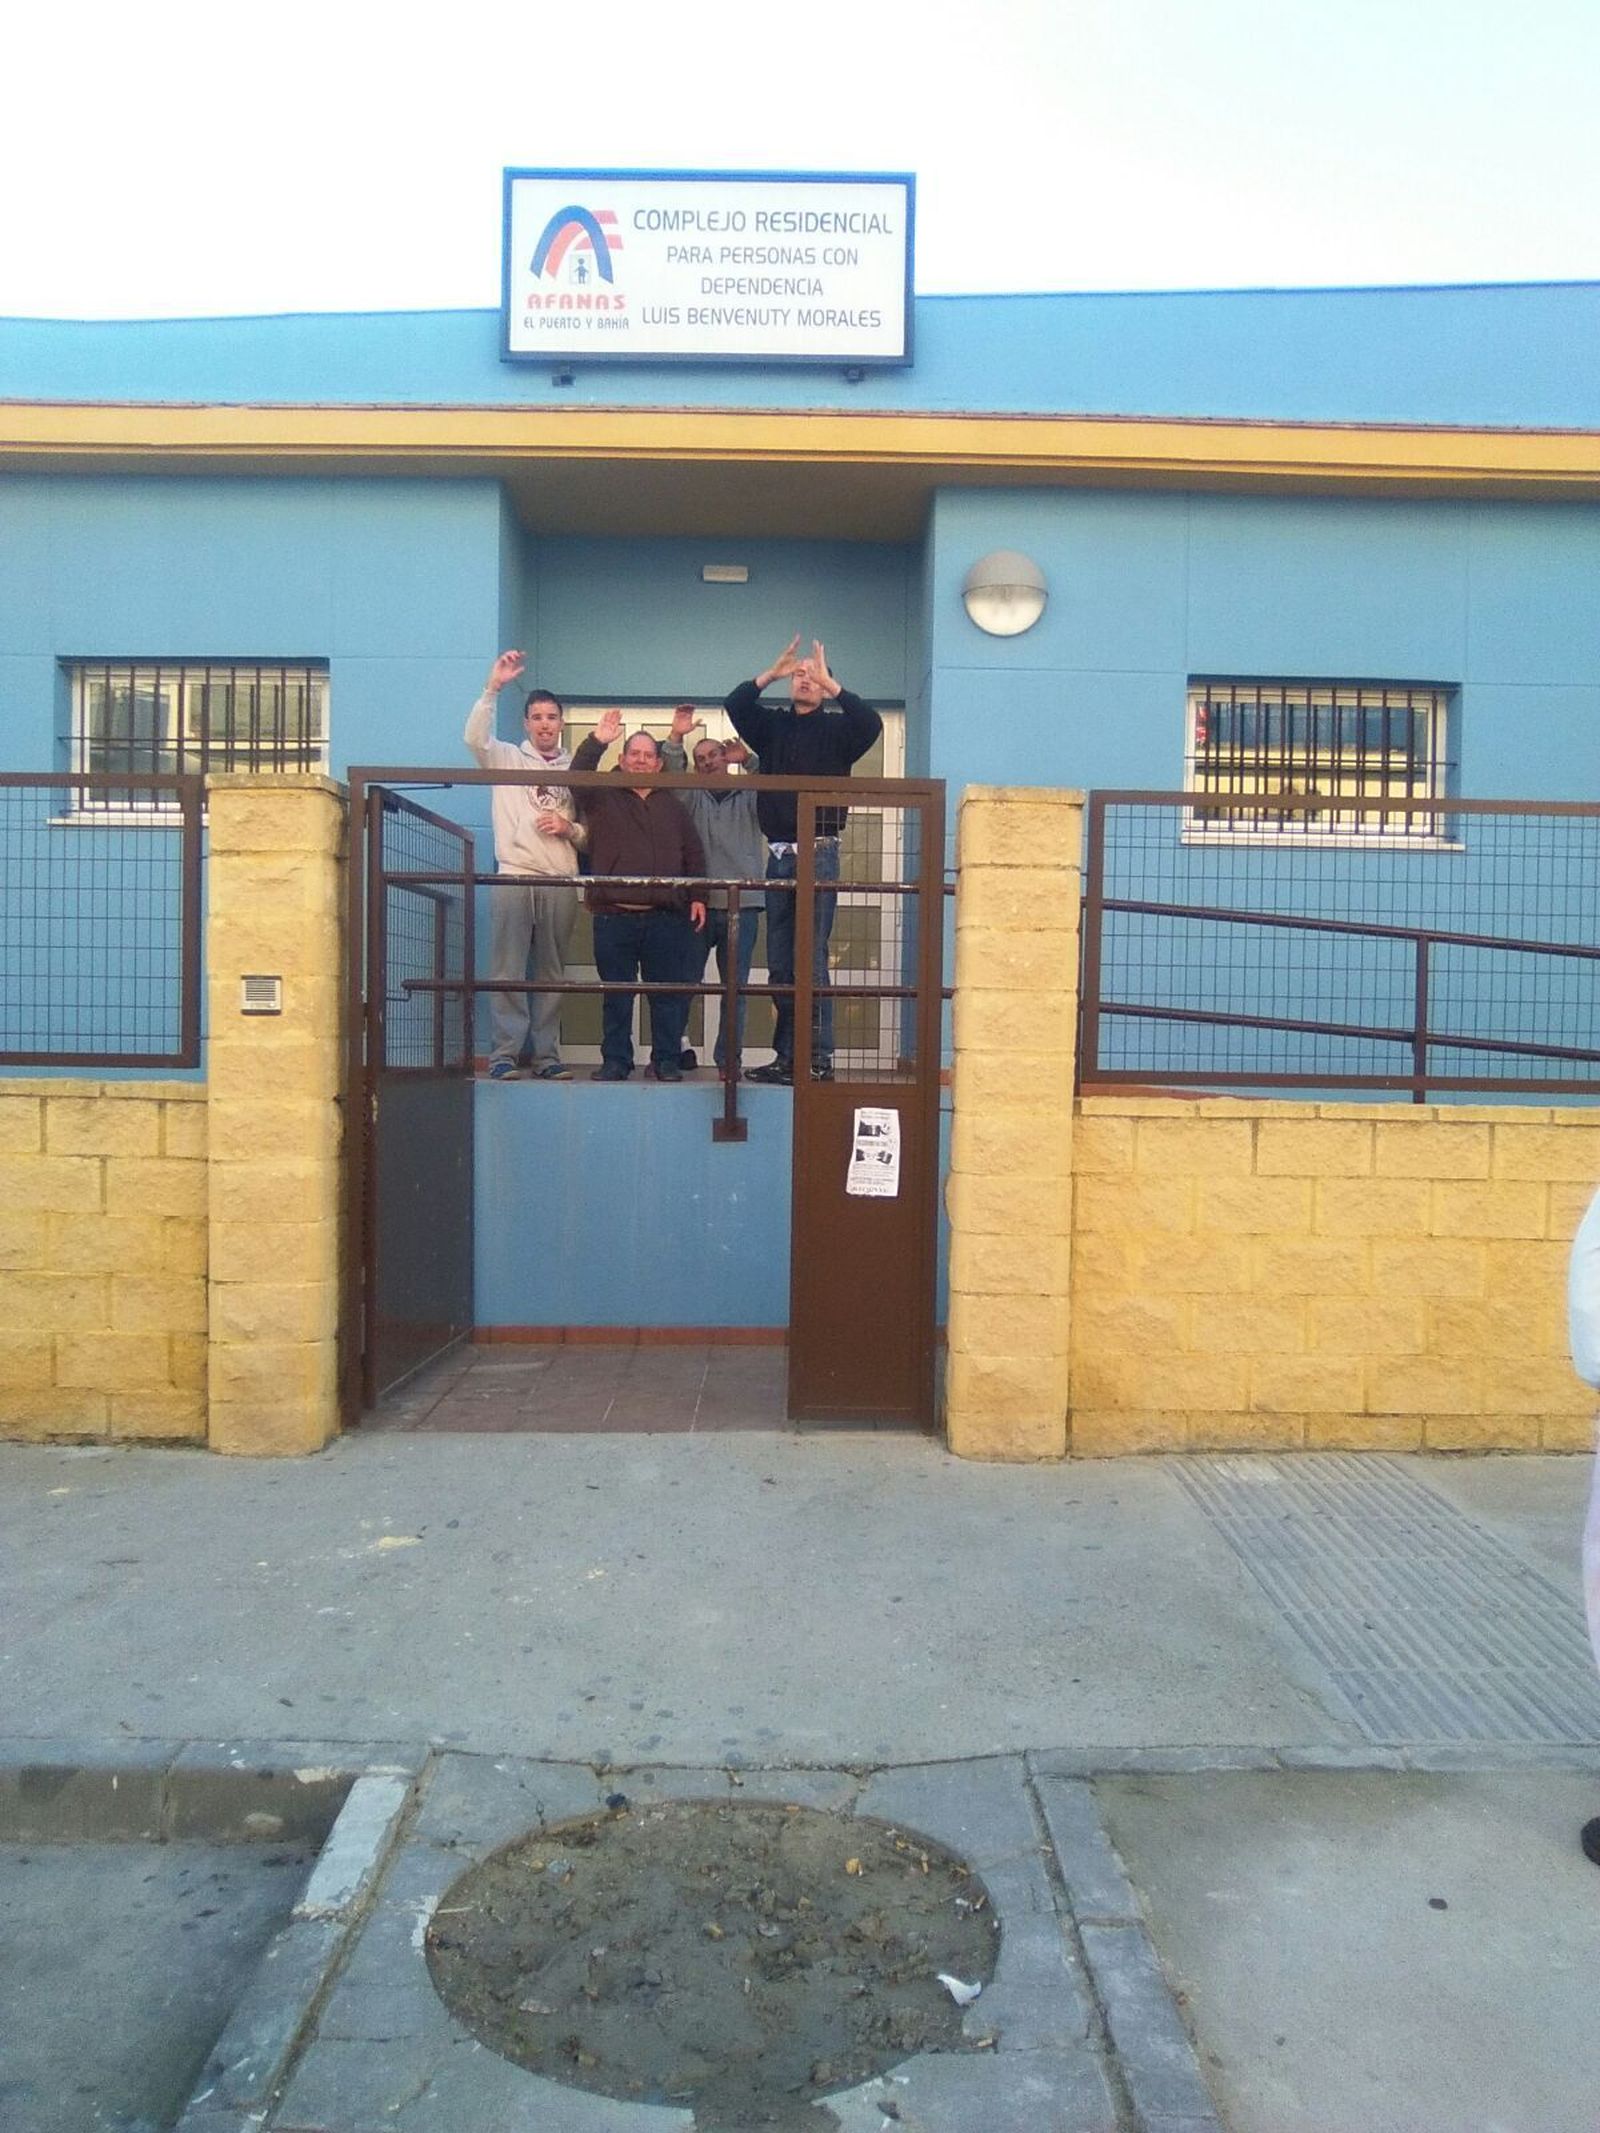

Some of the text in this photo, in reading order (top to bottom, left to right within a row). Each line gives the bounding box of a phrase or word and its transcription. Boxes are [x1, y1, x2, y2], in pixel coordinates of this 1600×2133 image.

[633, 208, 893, 235] COMPLEJO RESIDENCIAL
[667, 245, 859, 266] PARA PERSONAS CON
[701, 278, 824, 296] DEPENDENCIA
[527, 294, 626, 310] AFANAS
[523, 316, 535, 329] EL
[540, 316, 582, 329] PUERTO
[585, 316, 593, 329] Y
[642, 307, 882, 328] LUIS BENVENUTY MORALES
